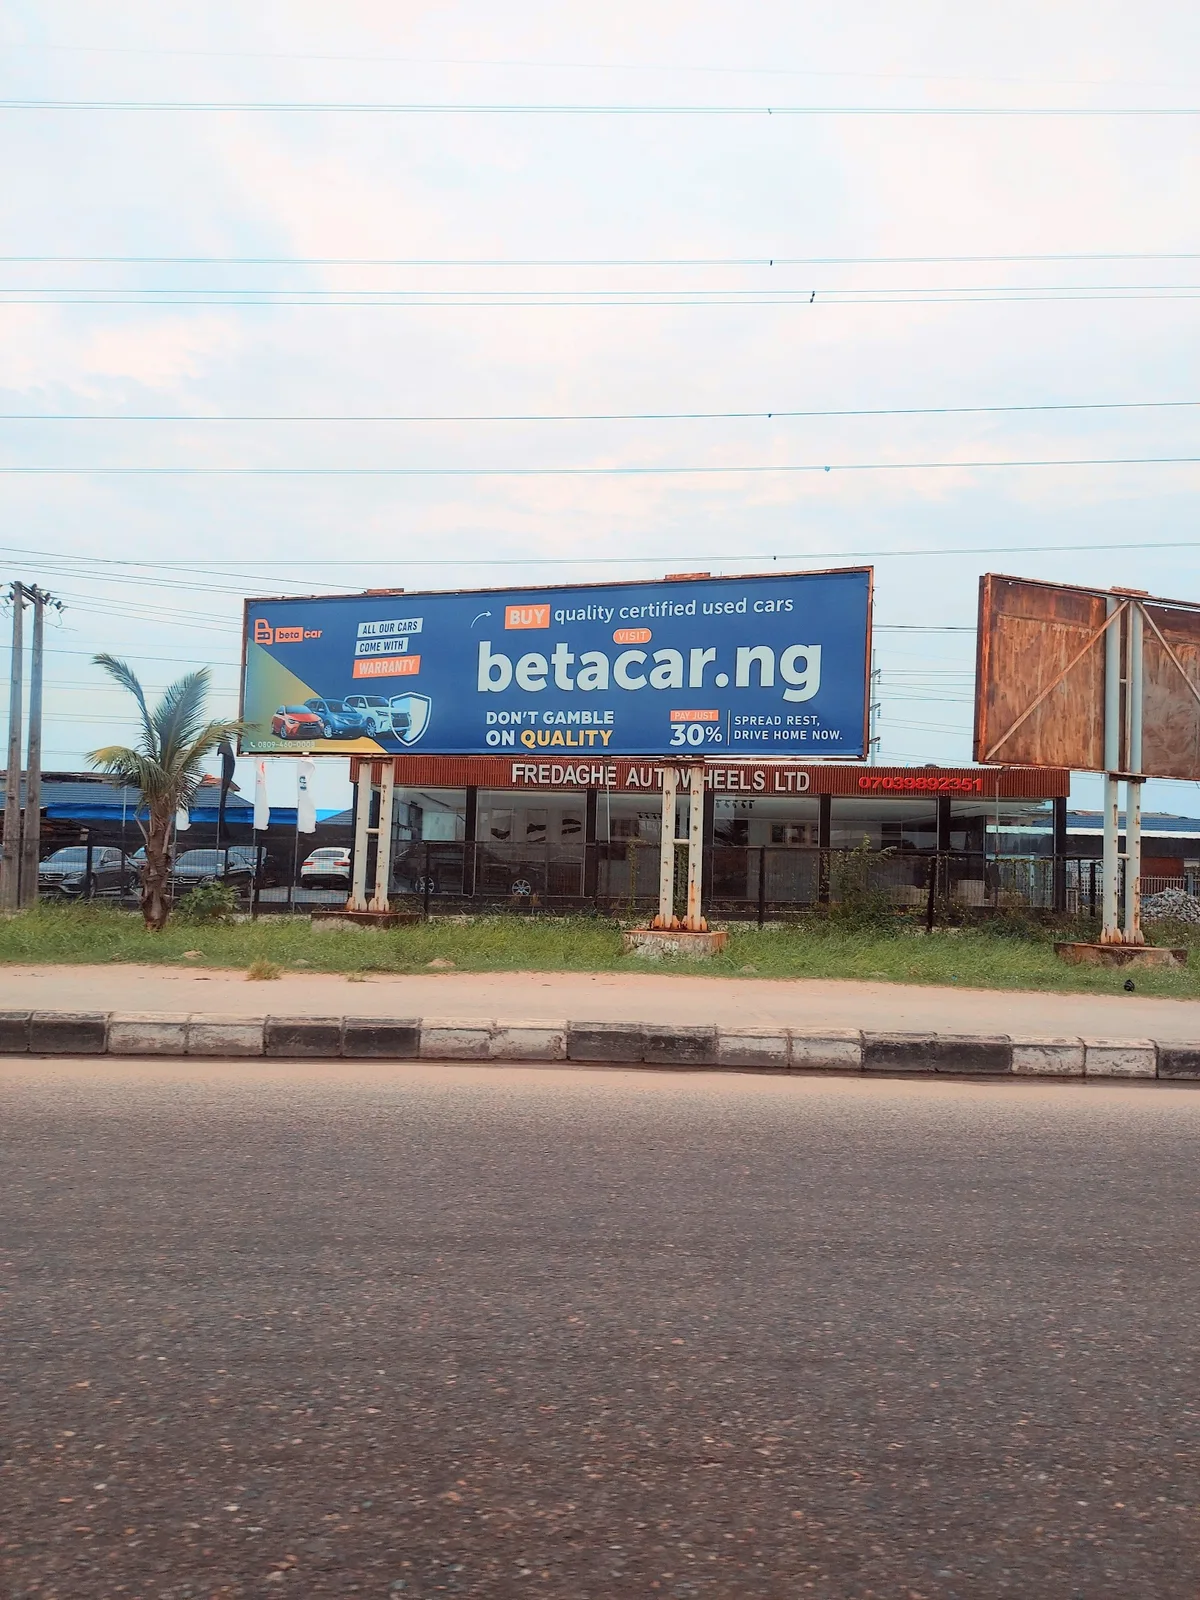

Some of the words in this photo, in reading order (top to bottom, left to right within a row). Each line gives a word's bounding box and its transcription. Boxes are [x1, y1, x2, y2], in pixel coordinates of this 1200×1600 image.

[510, 608, 546, 625] BUY
[554, 604, 615, 624] quality
[619, 600, 696, 619] certified
[702, 597, 748, 615] used
[753, 599, 794, 613] cars
[278, 631, 300, 639] beta
[303, 630, 323, 639] car
[363, 624, 376, 635] ALL
[379, 623, 395, 634] OUR
[397, 620, 418, 632] CARS
[618, 631, 647, 641] VISIT
[359, 642, 381, 653] COME
[383, 640, 404, 652] WITH
[359, 660, 415, 675] WARRANTY
[477, 640, 822, 703] betacar.ng
[486, 711, 539, 725] DON'T
[542, 710, 614, 725] GAMBLE
[674, 712, 689, 720] PAY
[693, 711, 714, 720] JUST
[734, 716, 782, 726] SPREAD
[786, 715, 821, 727] REST,
[485, 729, 515, 746] ON
[520, 729, 614, 749] QUALITY
[669, 723, 723, 747] 30%
[734, 730, 769, 741] DRIVE
[773, 730, 807, 740] HOME
[812, 730, 843, 740] NOW.
[511, 763, 617, 786] FREDAGHE
[775, 771, 810, 792] LTD
[858, 776, 983, 792] 07039892351
